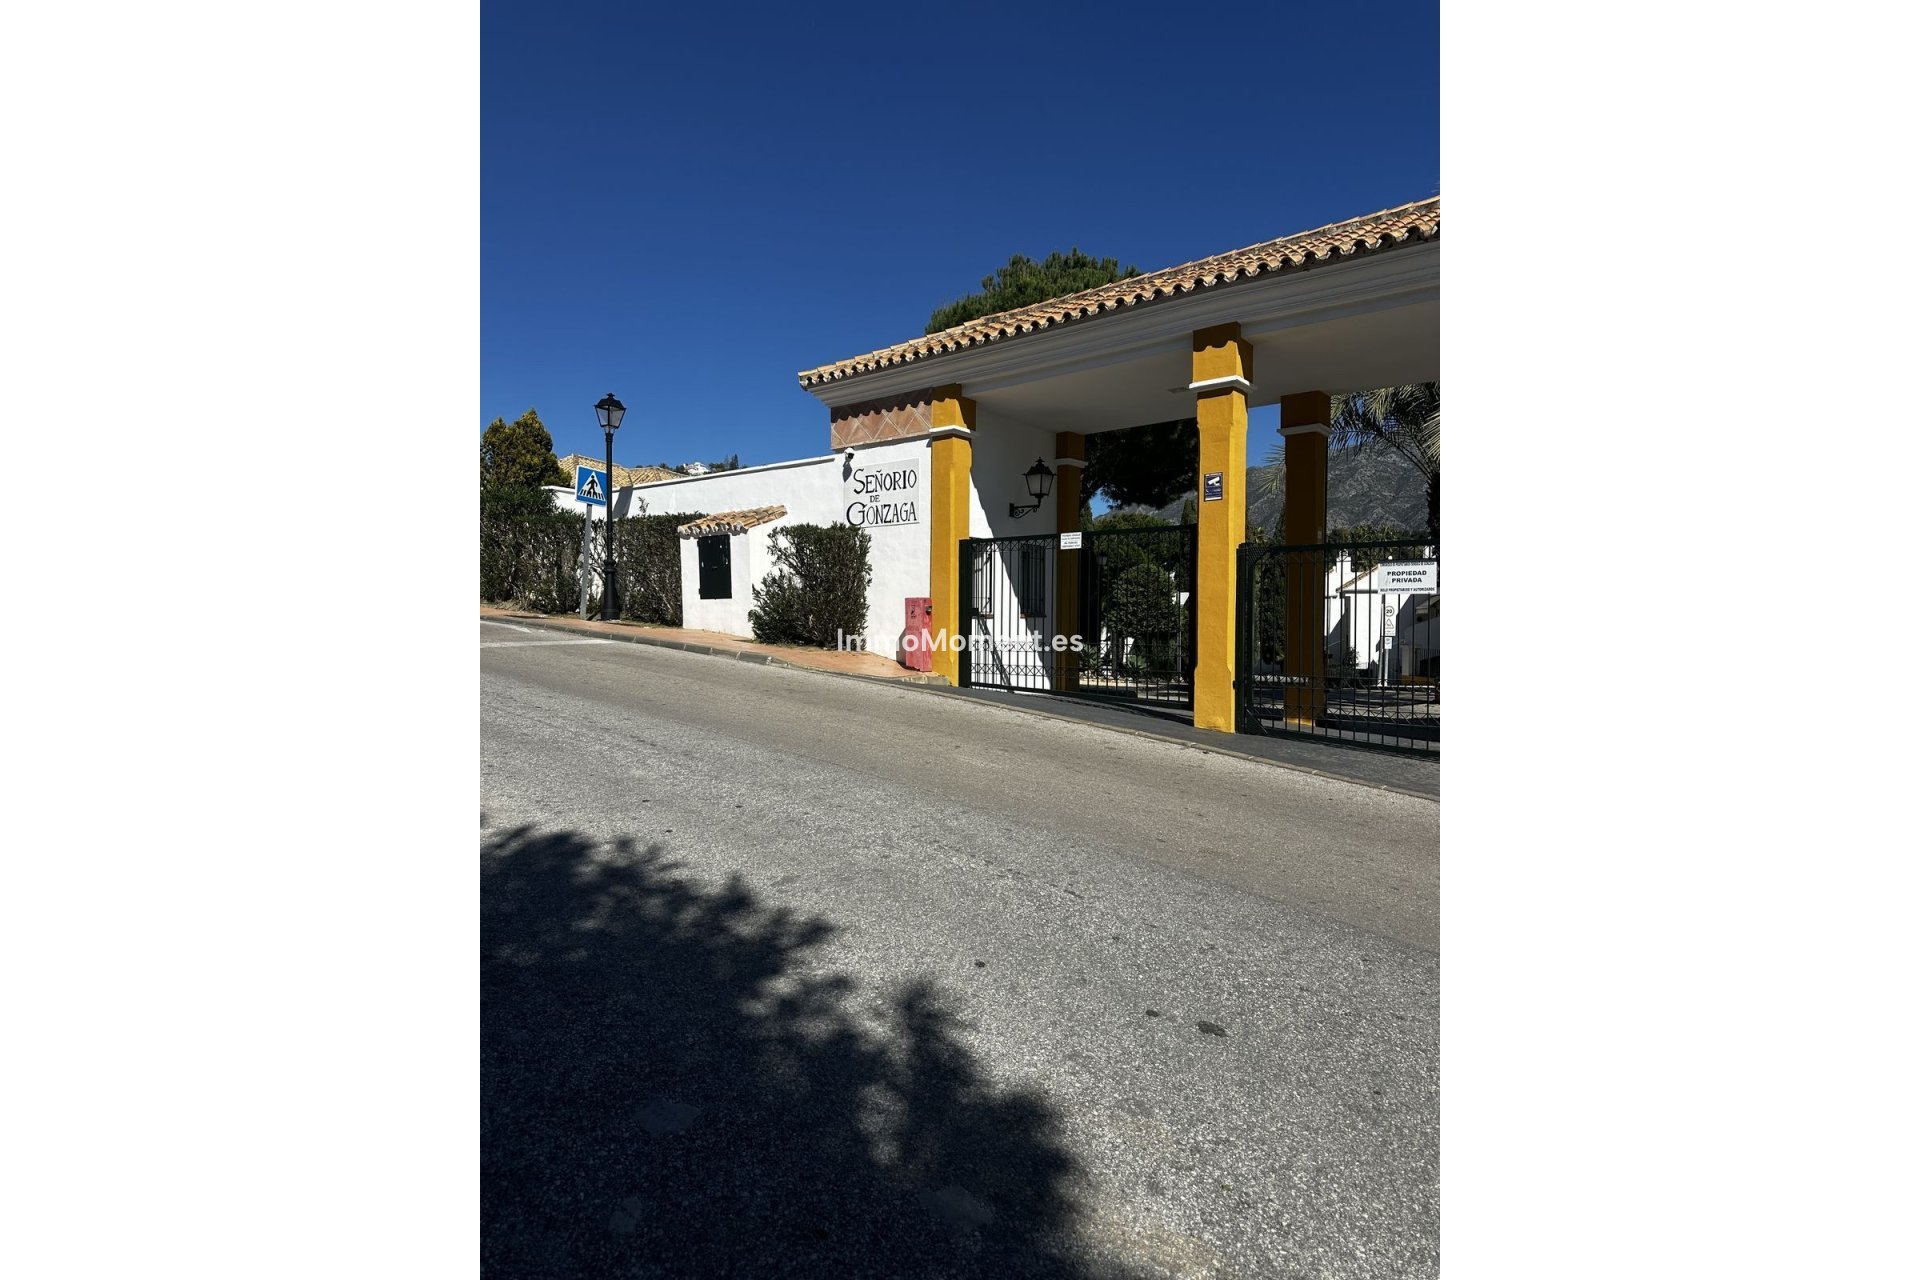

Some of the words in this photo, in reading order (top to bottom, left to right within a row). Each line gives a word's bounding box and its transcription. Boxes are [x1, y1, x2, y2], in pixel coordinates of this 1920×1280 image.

[853, 468, 917, 494] SEÑORIO
[869, 494, 880, 503] DE
[846, 501, 917, 526] GONZAGA
